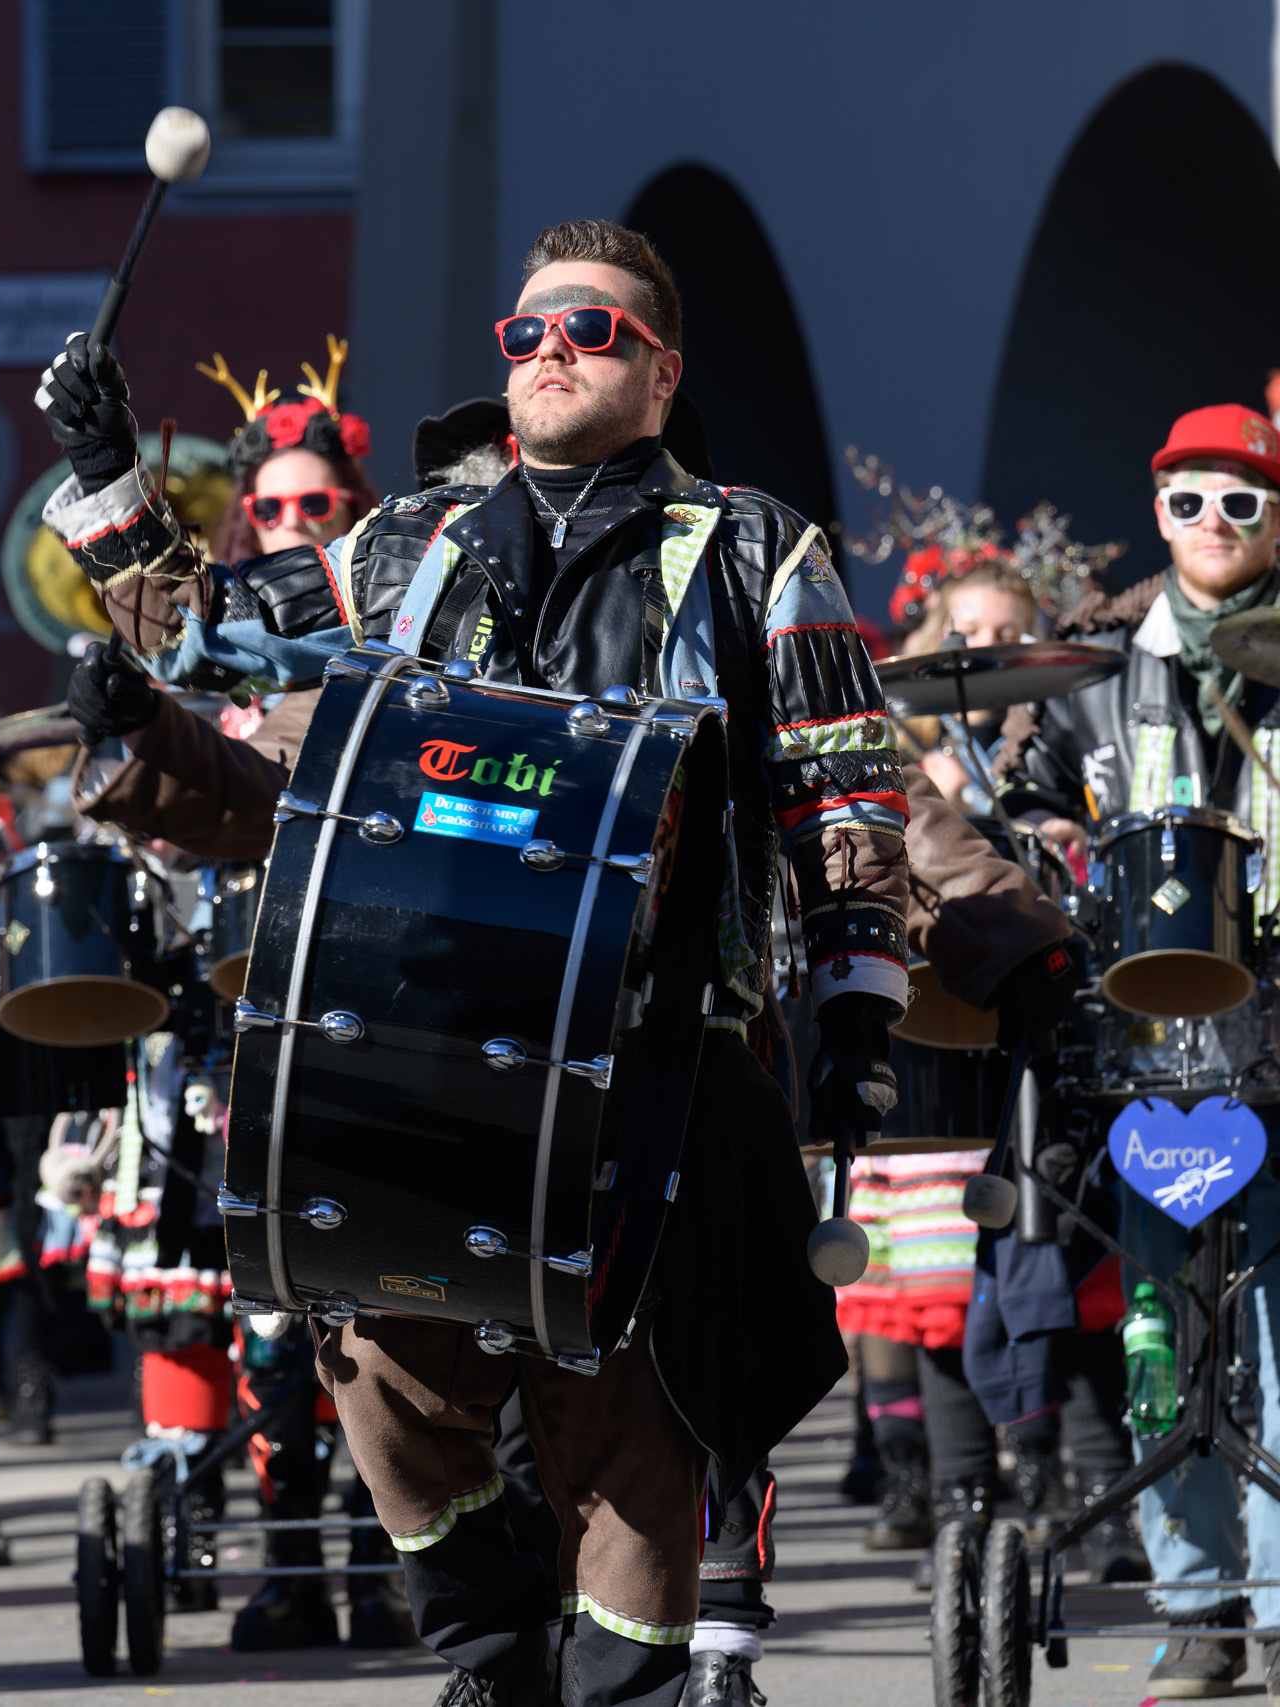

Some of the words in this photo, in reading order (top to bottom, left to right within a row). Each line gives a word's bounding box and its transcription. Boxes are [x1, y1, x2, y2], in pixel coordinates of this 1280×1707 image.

[419, 740, 563, 796] Tobi
[454, 802, 492, 816] BISCH
[493, 809, 519, 821] MIN
[1122, 1128, 1216, 1171] Aaron
